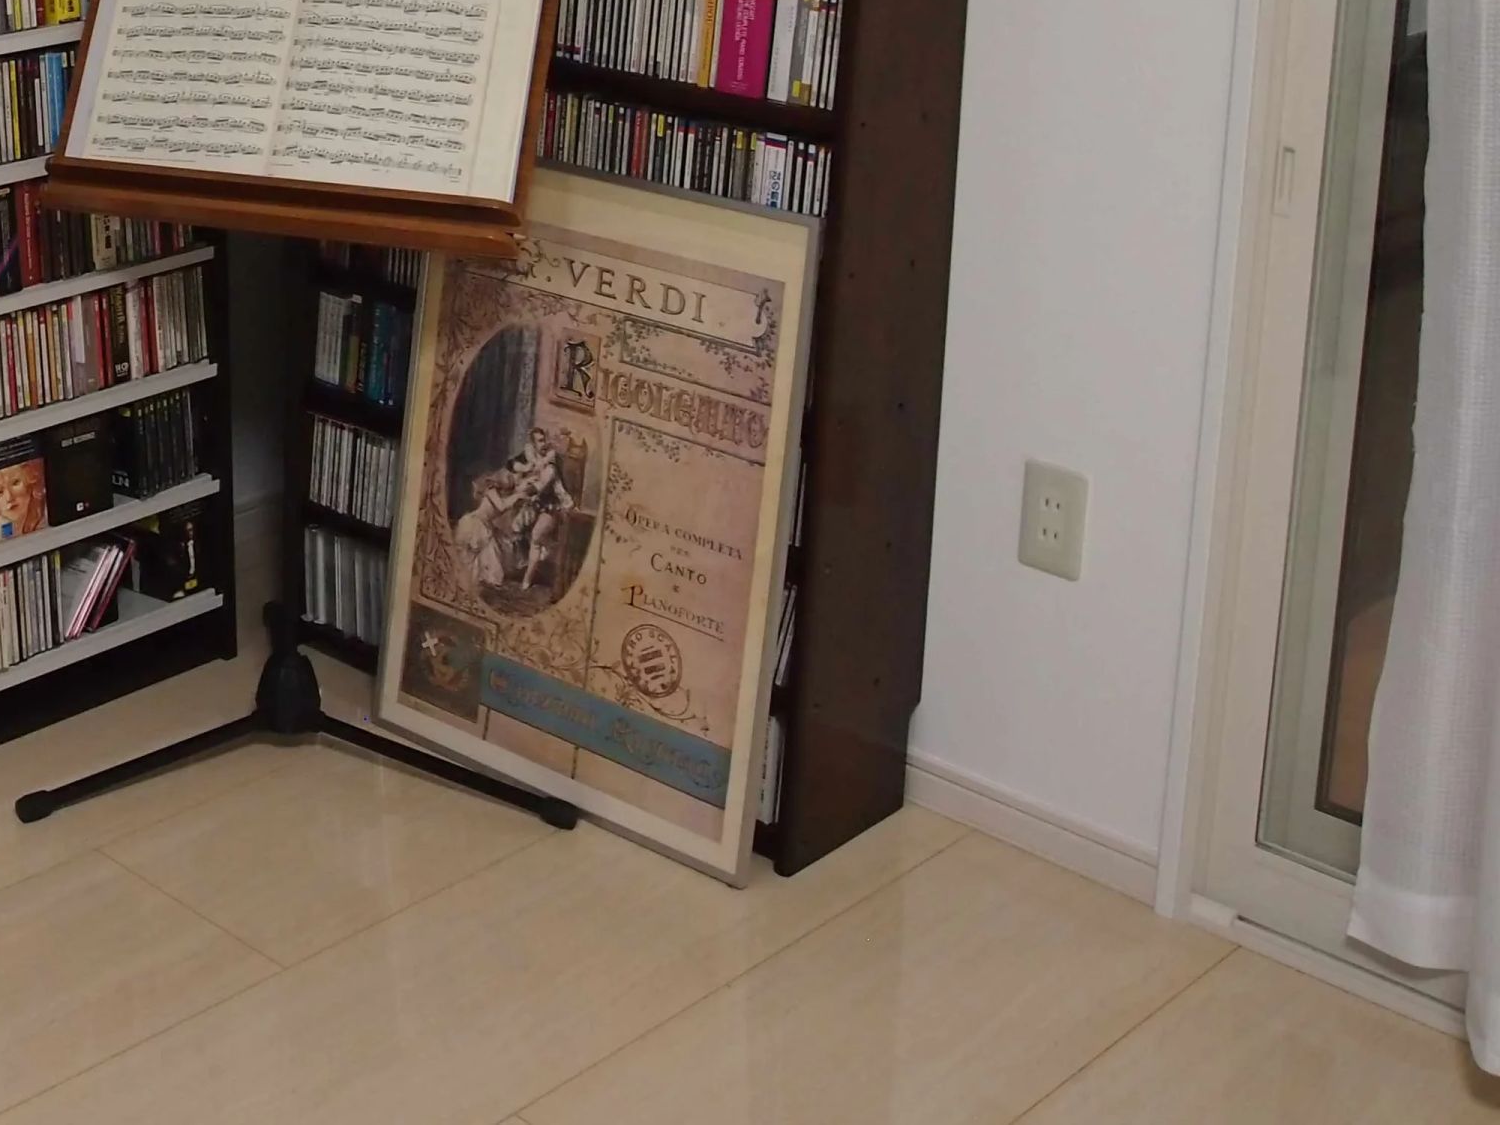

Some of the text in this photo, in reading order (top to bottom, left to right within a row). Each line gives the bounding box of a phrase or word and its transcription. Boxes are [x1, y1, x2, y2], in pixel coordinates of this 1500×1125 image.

[563, 257, 707, 324] VERDI
[674, 527, 743, 561] COMPLETA
[650, 553, 708, 586] CANTO
[621, 585, 725, 636] PIANOFORTE
